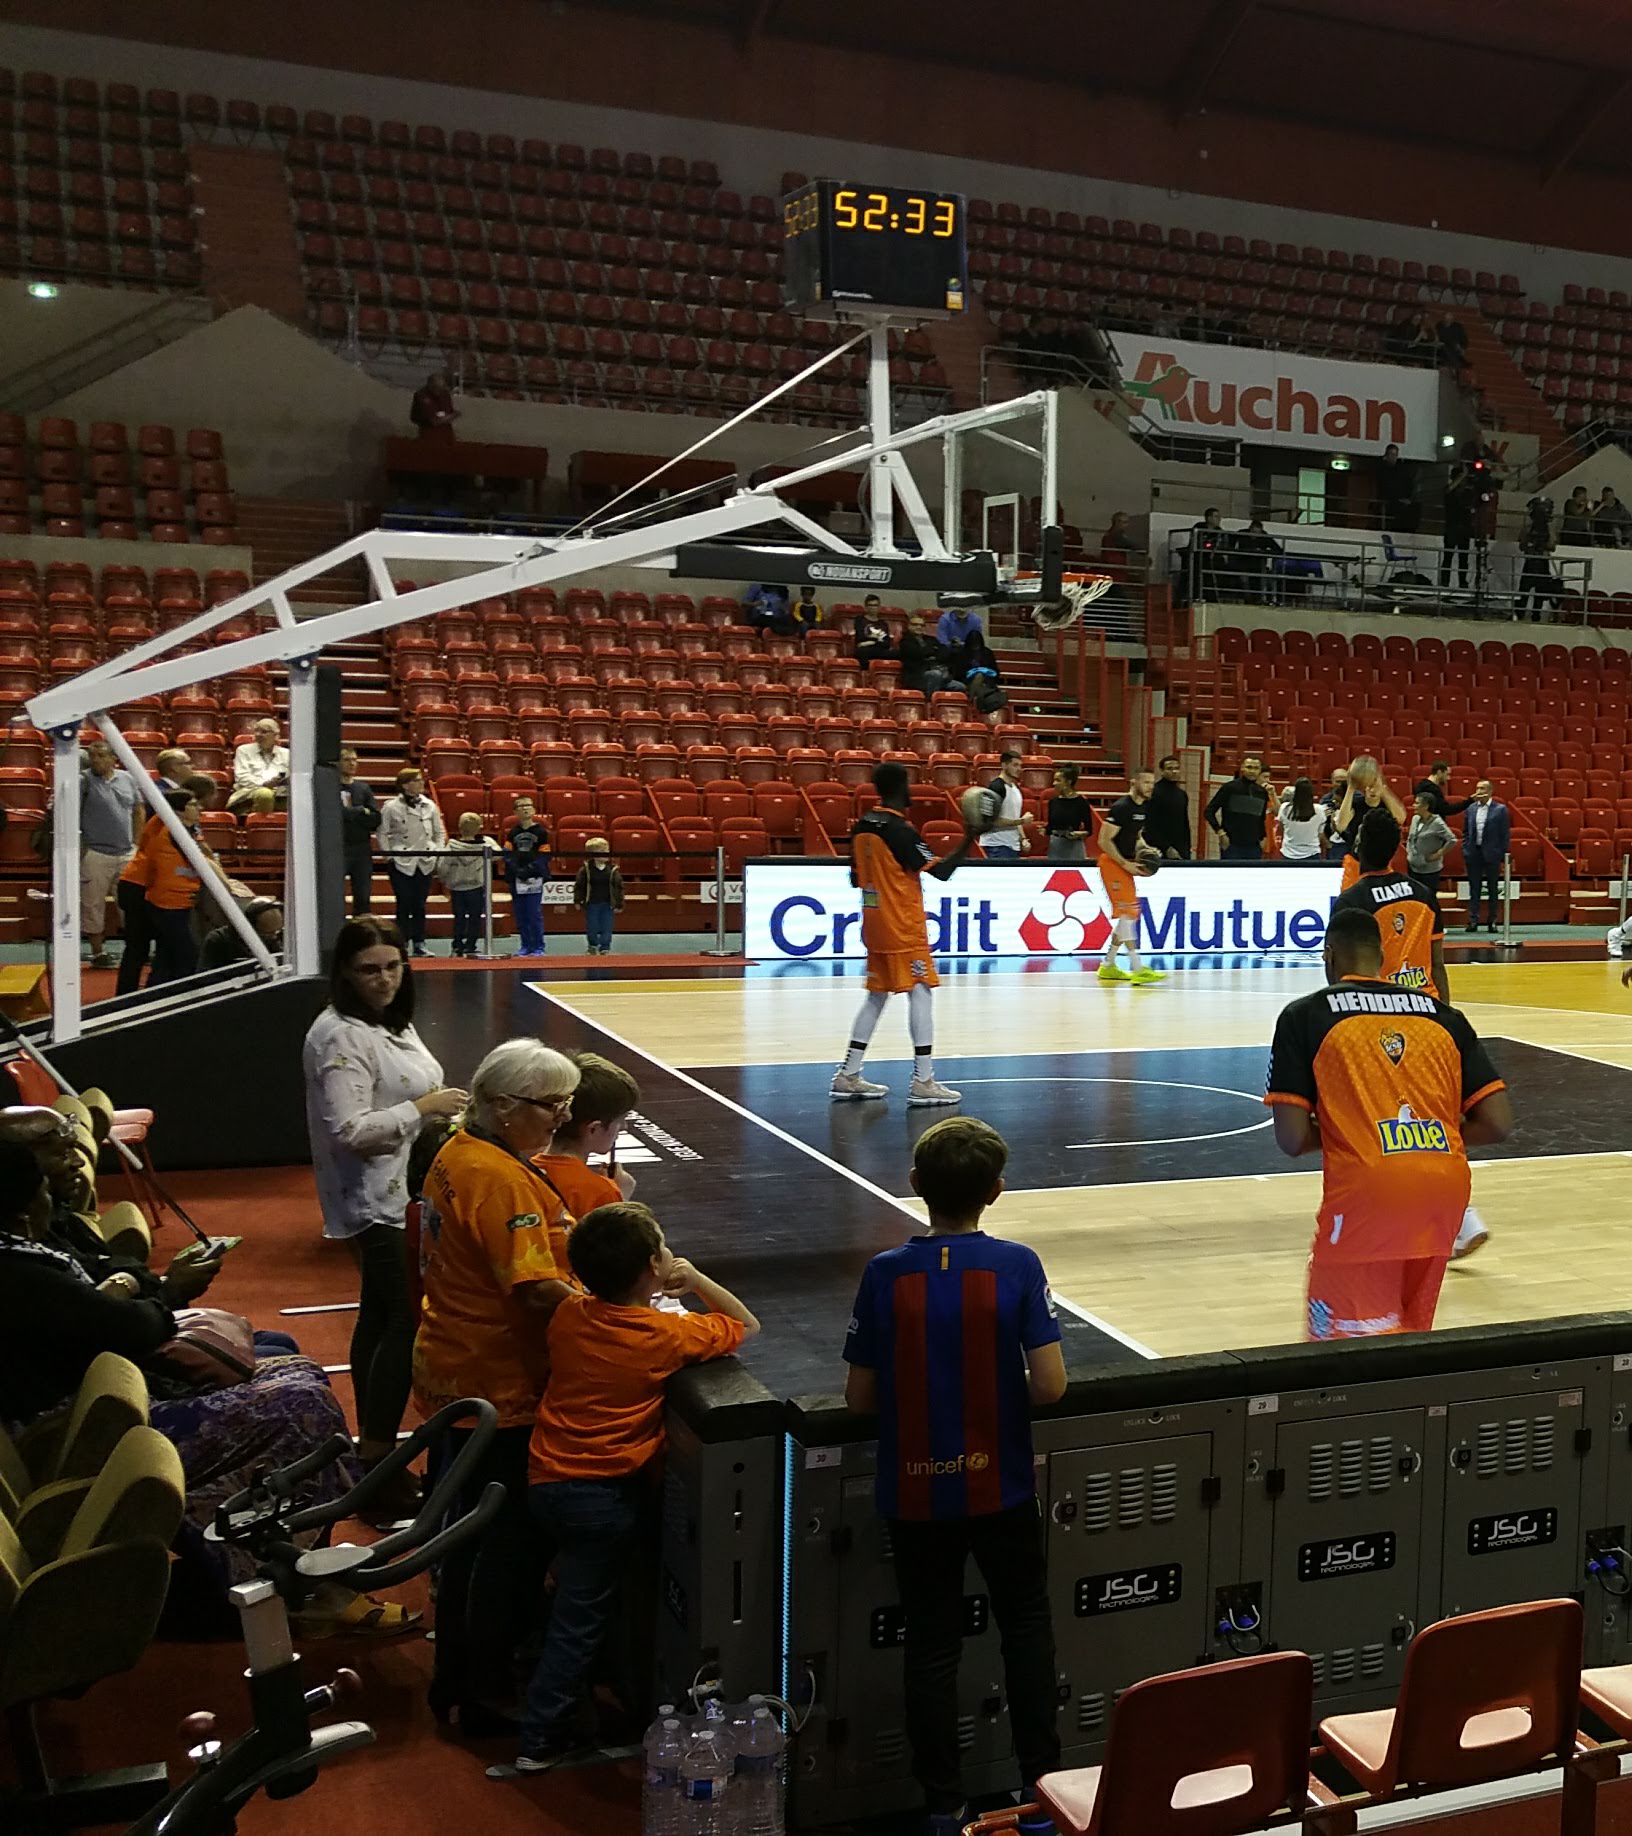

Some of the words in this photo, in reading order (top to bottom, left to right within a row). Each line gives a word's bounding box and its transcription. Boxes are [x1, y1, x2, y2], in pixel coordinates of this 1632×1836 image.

[835, 191, 954, 236] 52:33
[1128, 352, 1406, 444] Auchan
[770, 895, 998, 956] Crdit
[1136, 896, 1340, 950] Mutue
[1383, 1120, 1447, 1150] Loué
[907, 1454, 964, 1475] unicef
